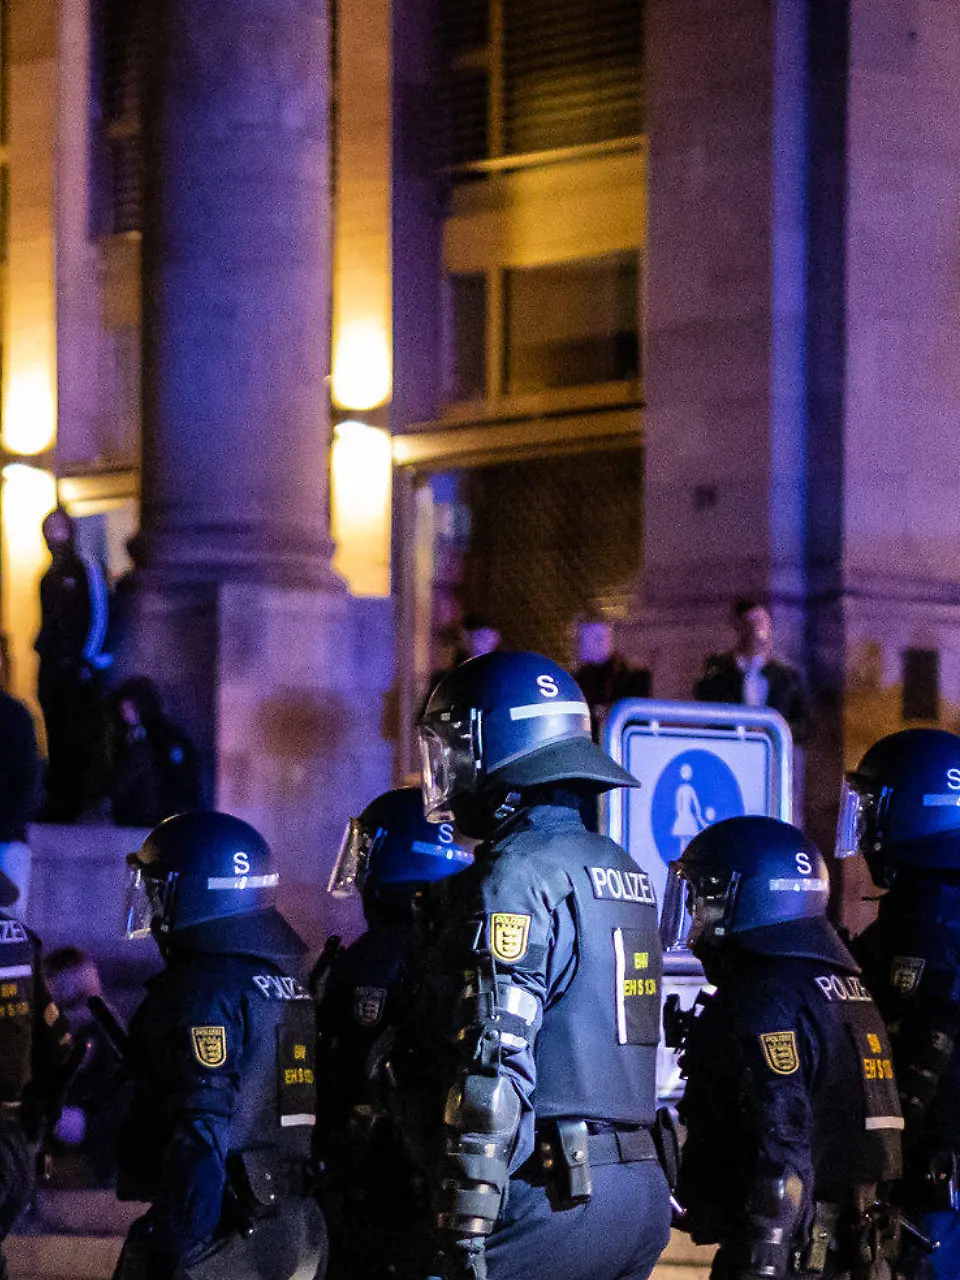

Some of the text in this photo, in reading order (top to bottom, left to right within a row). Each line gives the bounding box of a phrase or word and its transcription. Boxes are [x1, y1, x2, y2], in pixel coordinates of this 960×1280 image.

[536, 674, 559, 698] S
[947, 768, 960, 790] S
[438, 823, 454, 843] S
[233, 851, 250, 875] S
[794, 852, 812, 874] S
[591, 867, 655, 903] POLIZEI
